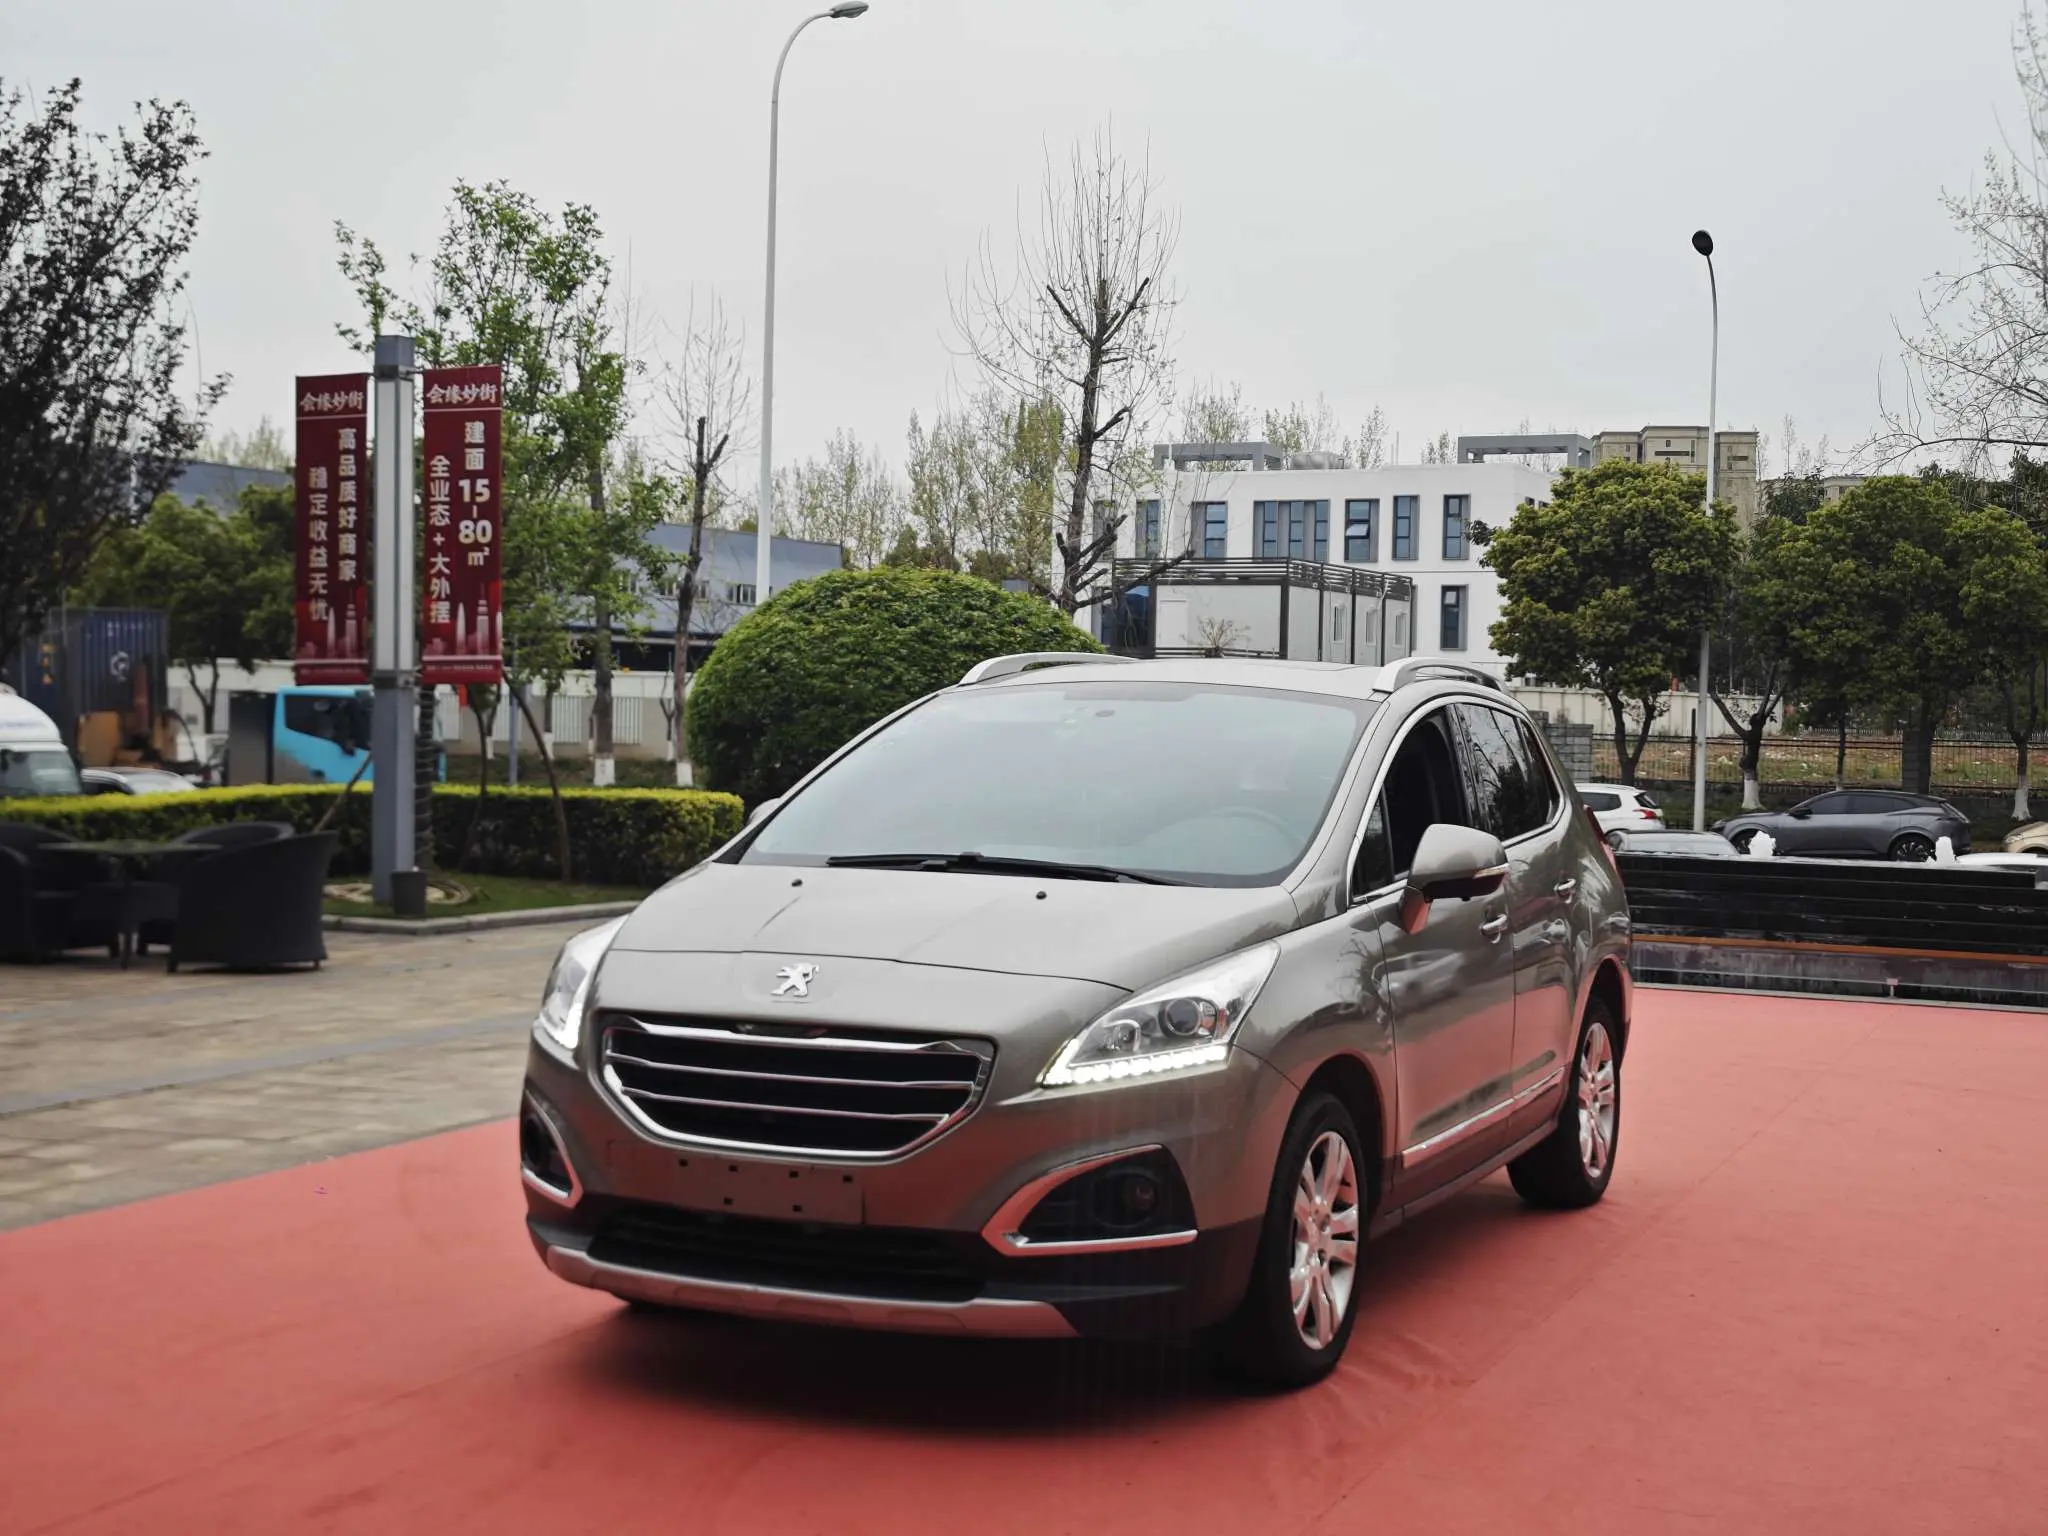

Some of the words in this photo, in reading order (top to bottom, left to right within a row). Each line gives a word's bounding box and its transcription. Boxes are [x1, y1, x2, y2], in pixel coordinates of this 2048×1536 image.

[338, 428, 357, 582] 高品质好商家
